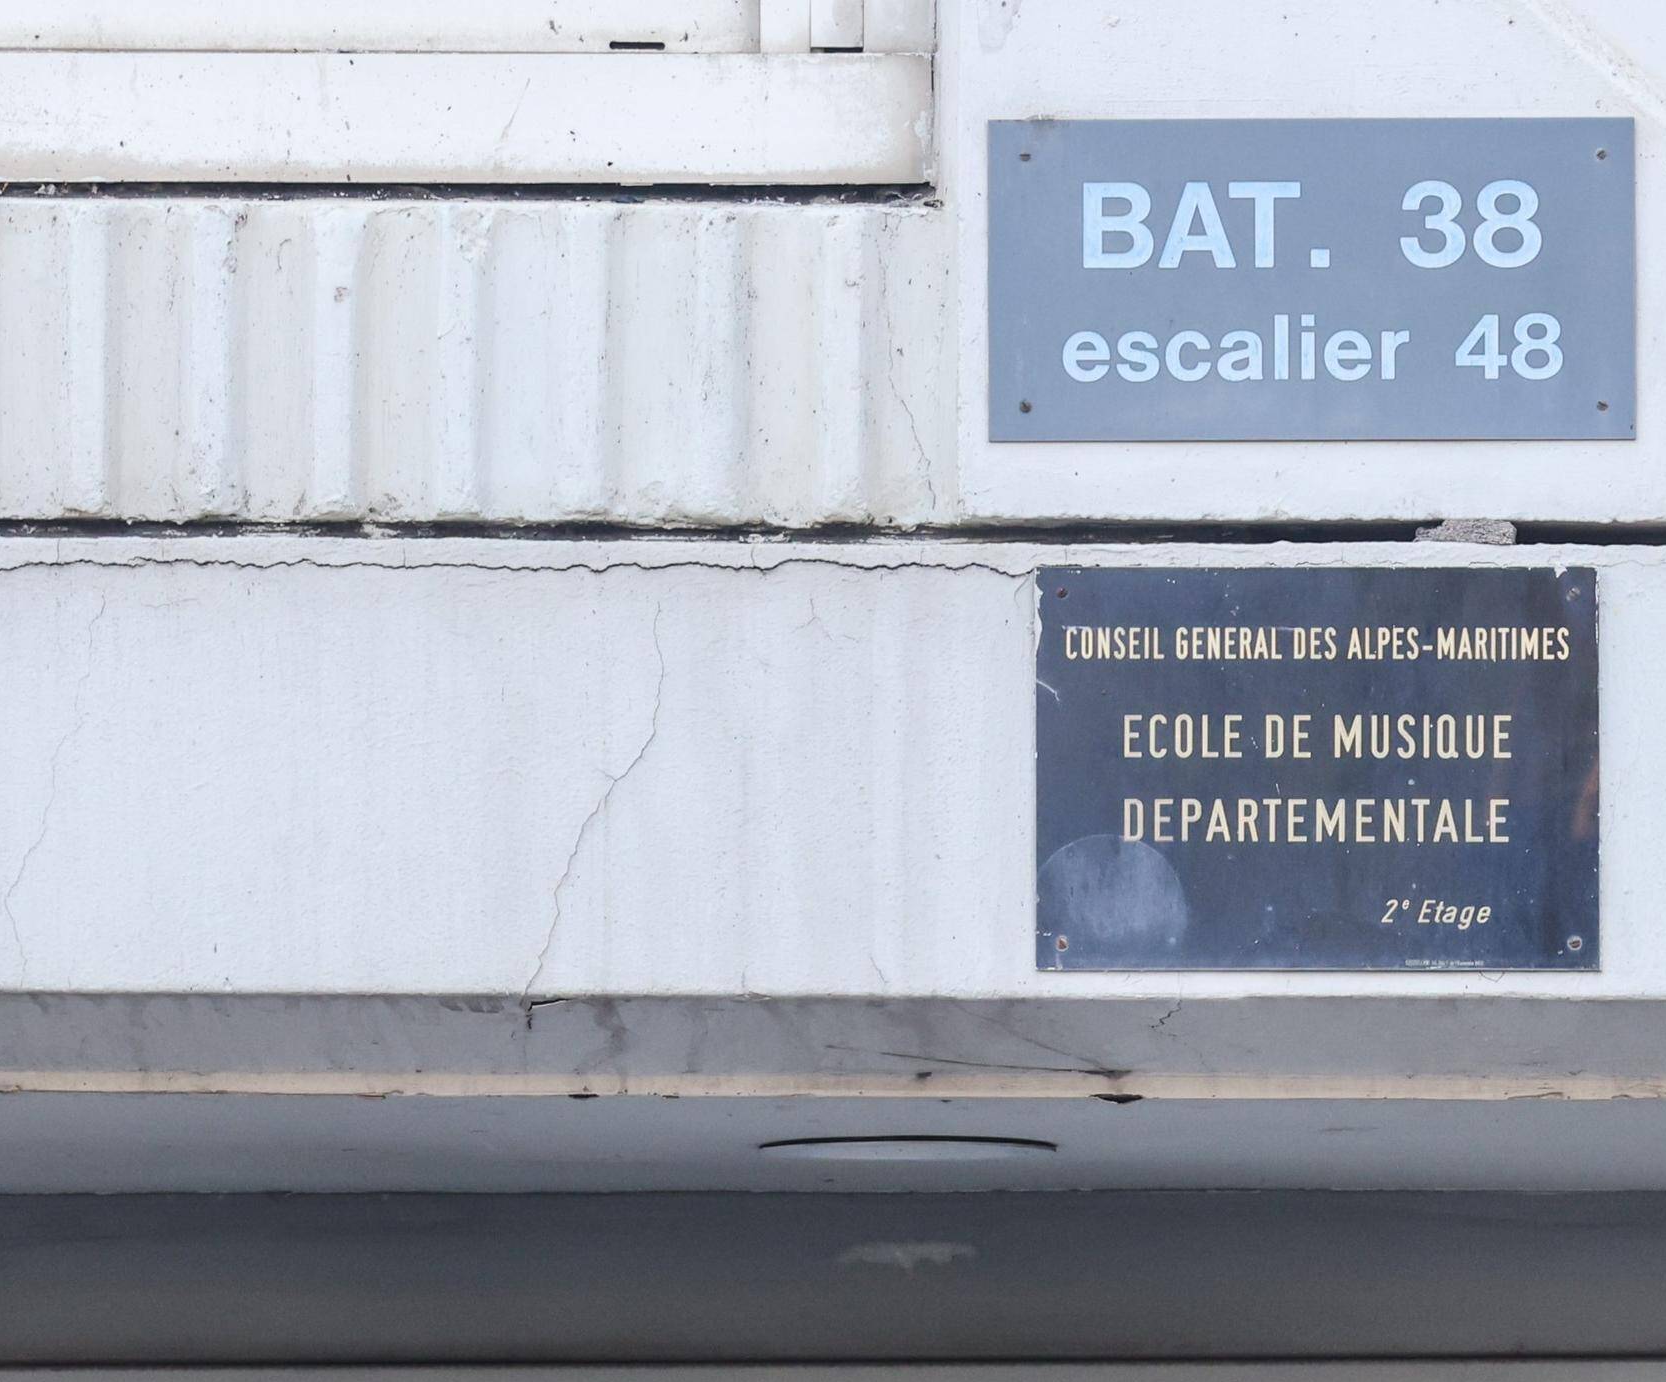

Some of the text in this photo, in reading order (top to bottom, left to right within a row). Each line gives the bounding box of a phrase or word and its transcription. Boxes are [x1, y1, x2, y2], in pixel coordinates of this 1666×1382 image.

[1082, 178, 1543, 269] BAT. 38
[1061, 312, 1564, 382] escalier 48
[1064, 627, 1570, 662] CONSEIL GENERAL DES ALPES-MARITIMES
[1123, 714, 1513, 759] ECOLE DE MUSIQUE
[1123, 798, 1510, 843] DEPARTEMENTALE
[1417, 899, 1492, 929] Etage
